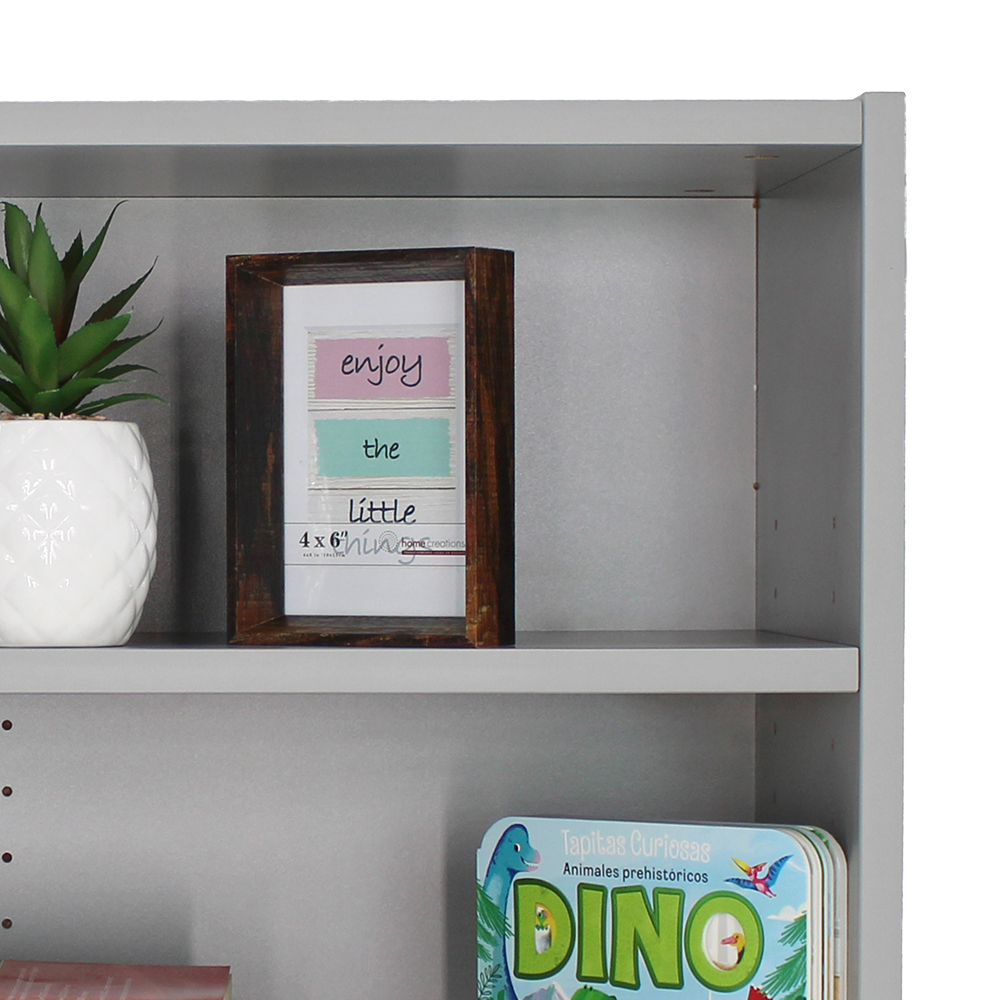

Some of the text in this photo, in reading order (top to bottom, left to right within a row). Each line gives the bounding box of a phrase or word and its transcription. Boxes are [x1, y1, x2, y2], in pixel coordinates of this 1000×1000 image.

[341, 344, 423, 387] enjoy
[363, 438, 400, 460] the
[349, 497, 417, 525] little
[299, 531, 311, 548] 4
[313, 536, 326, 548] x
[561, 829, 712, 863] Tapitas Curiosas
[563, 862, 709, 883] Animales prehistóricos
[513, 877, 765, 993] DINO
